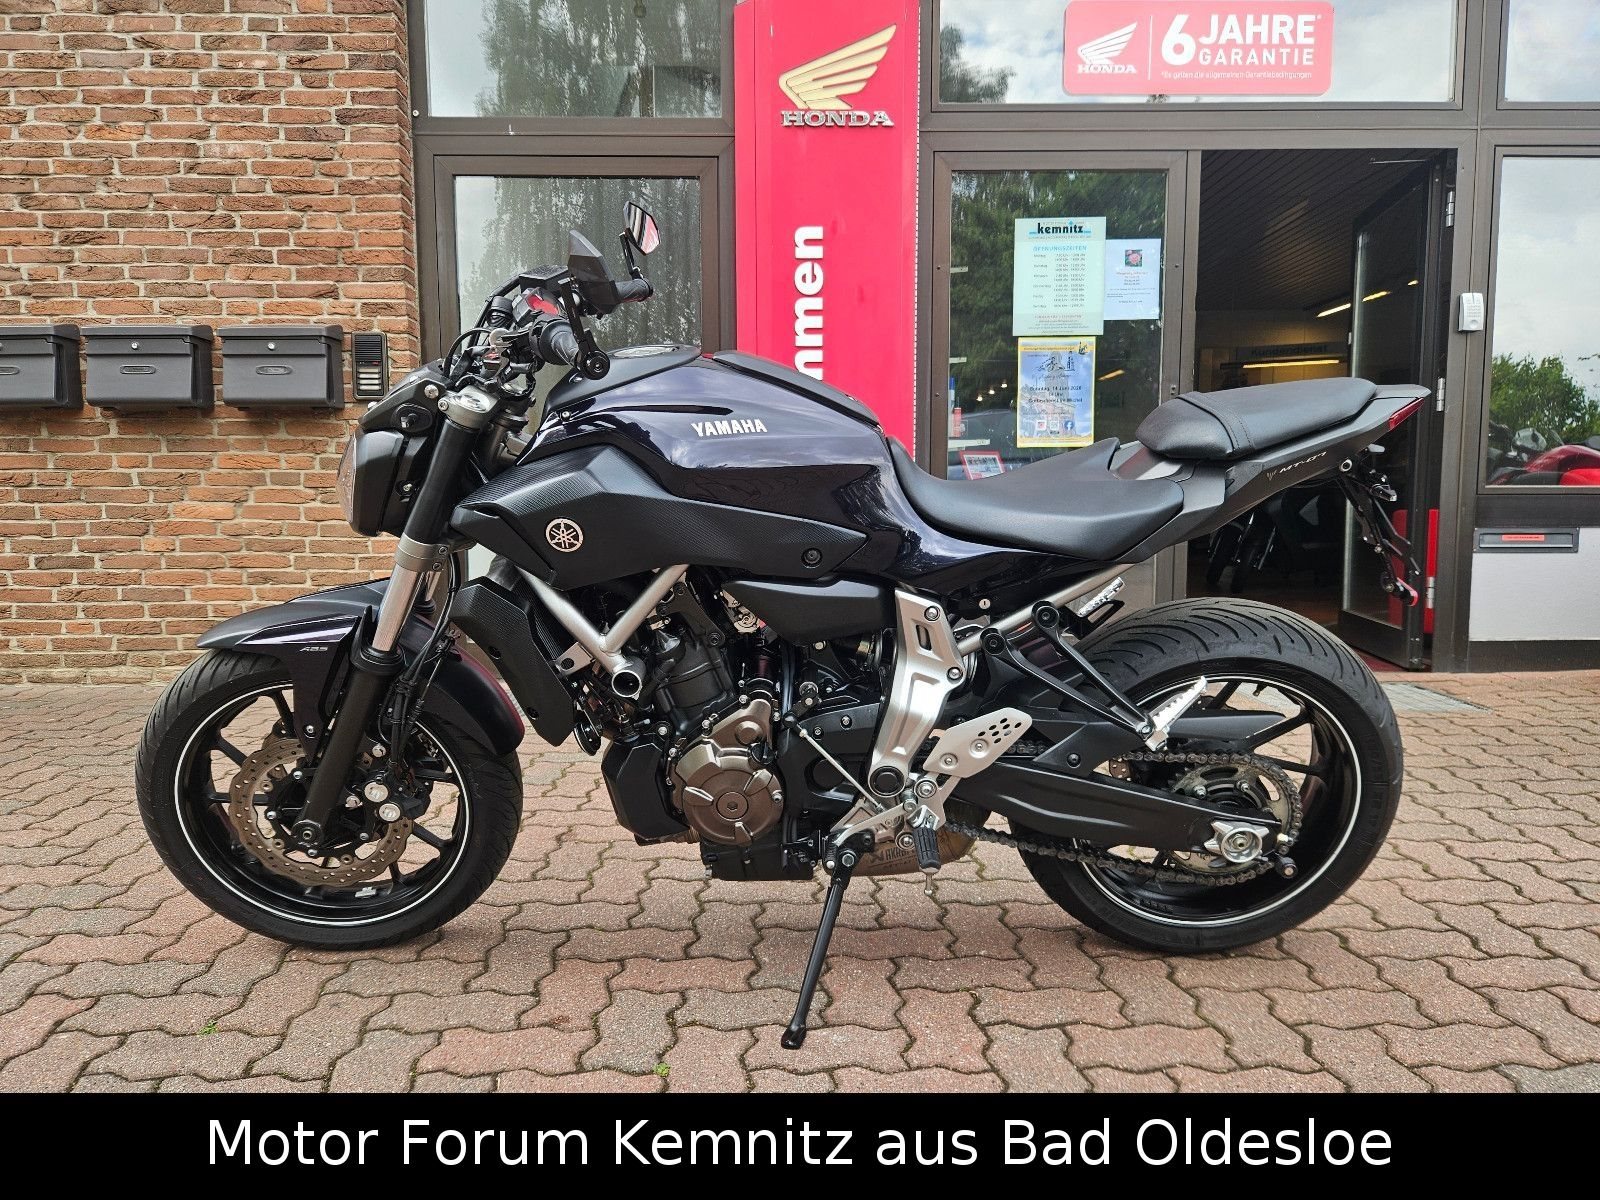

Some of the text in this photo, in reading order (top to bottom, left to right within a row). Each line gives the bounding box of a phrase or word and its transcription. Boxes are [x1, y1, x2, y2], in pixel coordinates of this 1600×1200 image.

[1161, 14, 1197, 66] 6
[1198, 48, 1314, 66] GARANTIE
[1077, 63, 1138, 74] HONDA
[780, 110, 895, 128] HONDA
[1037, 222, 1084, 235] kemnitz
[691, 418, 768, 437] YAMAHA
